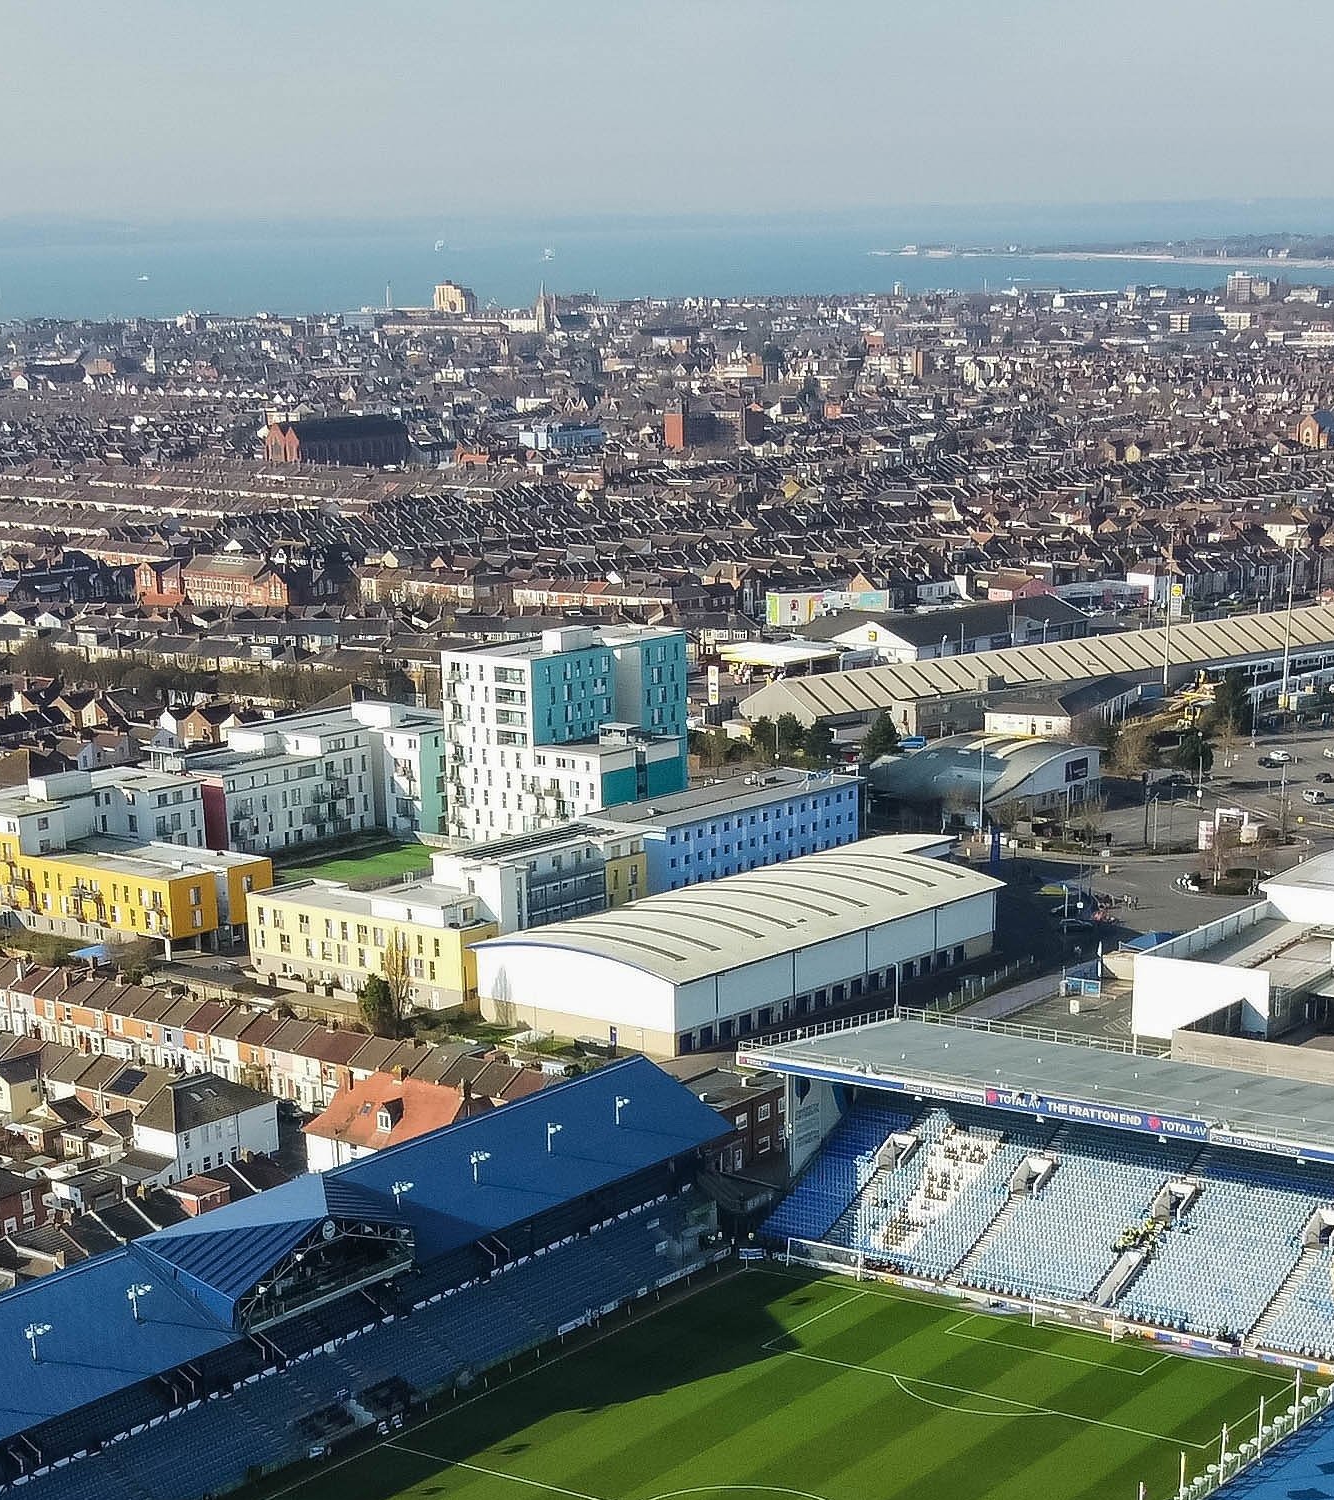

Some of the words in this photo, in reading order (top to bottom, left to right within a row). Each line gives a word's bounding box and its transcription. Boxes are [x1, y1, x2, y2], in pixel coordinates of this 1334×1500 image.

[1047, 1102, 1067, 1114] THE
[1069, 1104, 1118, 1122] FRATTON
[1120, 1114, 1142, 1126] END
